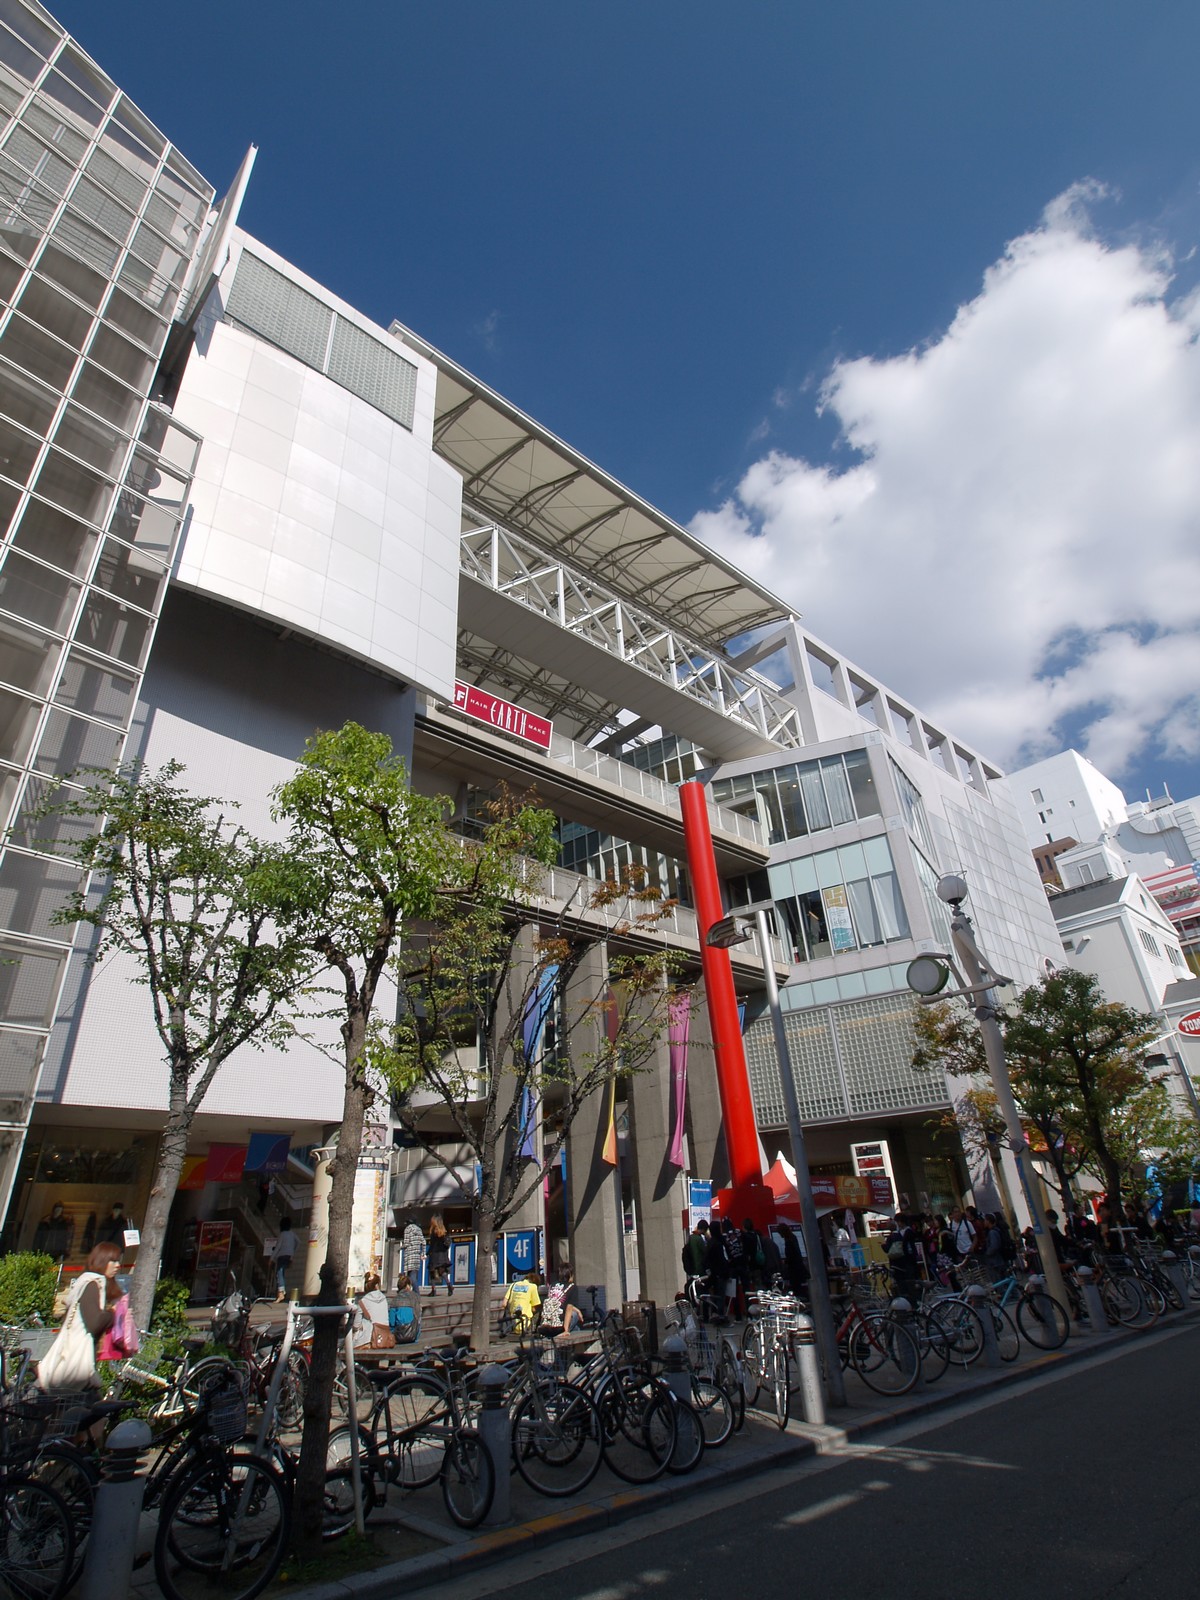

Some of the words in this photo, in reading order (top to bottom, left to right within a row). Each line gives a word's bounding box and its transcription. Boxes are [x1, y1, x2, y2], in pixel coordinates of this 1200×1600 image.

[454, 690, 466, 702] F
[470, 698, 488, 709] HAIR
[490, 701, 527, 736] EARTH
[528, 724, 546, 735] MAKE
[513, 1239, 530, 1258] 4F
